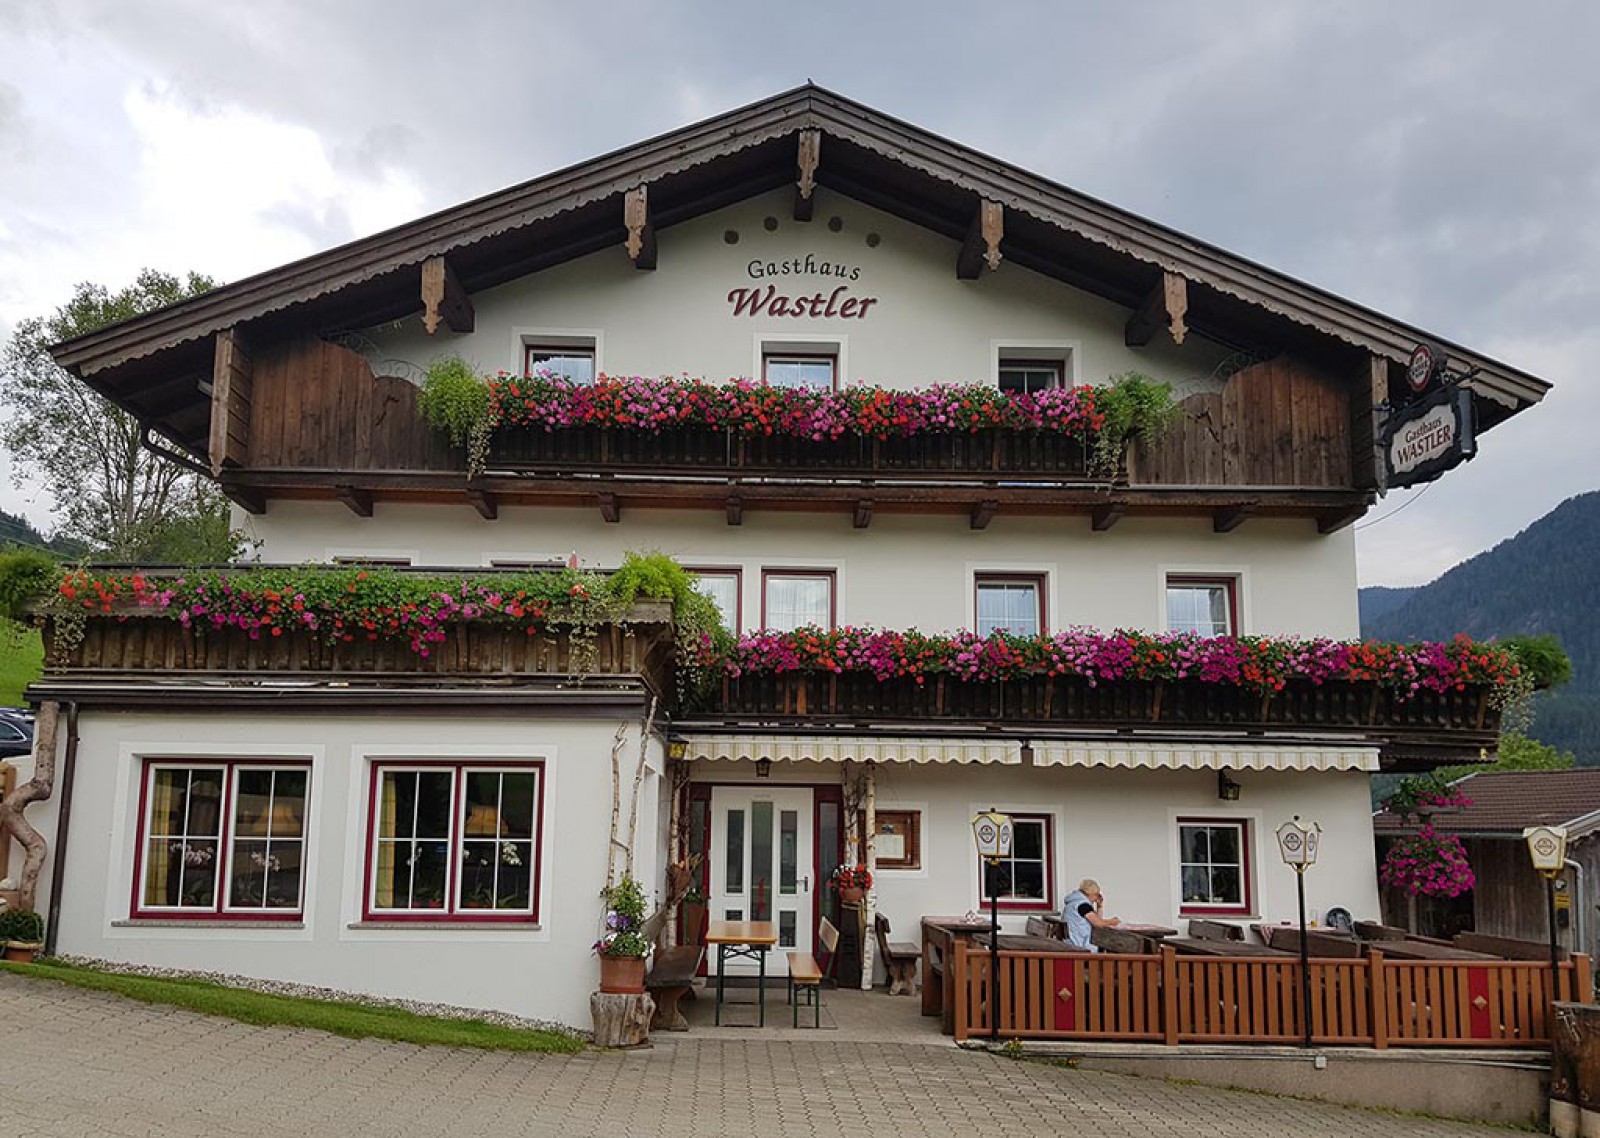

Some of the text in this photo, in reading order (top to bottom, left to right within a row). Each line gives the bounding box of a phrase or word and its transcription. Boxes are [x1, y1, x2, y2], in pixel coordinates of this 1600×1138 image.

[747, 253, 861, 280] Gasthaus
[727, 284, 878, 318] Wastler
[1397, 424, 1451, 464] WASTLER
[1405, 416, 1442, 443] Gasthaus
